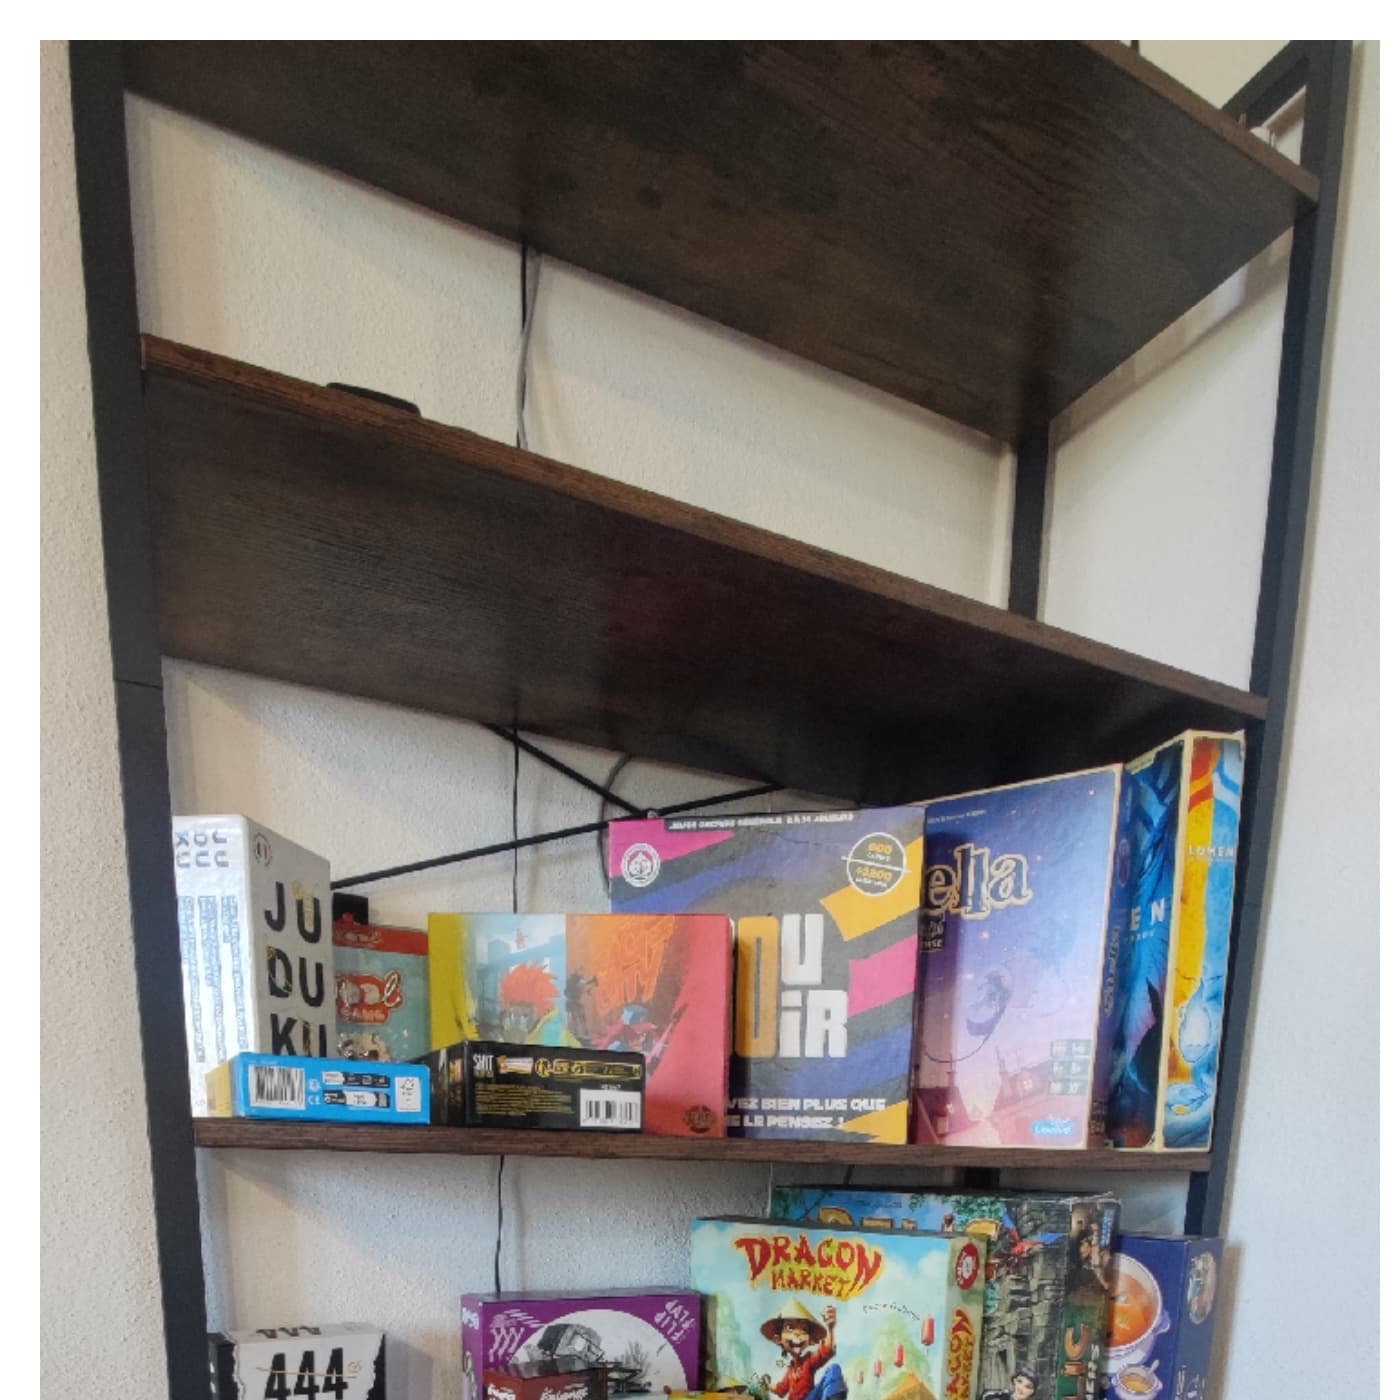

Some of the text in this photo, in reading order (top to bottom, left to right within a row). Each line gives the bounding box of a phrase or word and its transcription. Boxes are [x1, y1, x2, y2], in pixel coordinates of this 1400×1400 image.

[263, 880, 322, 943] JU
[267, 946, 324, 1008] DU
[803, 1098, 848, 1111] PLUS
[851, 1098, 886, 1112] QUE
[735, 1234, 882, 1294] DRAGON
[772, 1268, 851, 1298] MARKET
